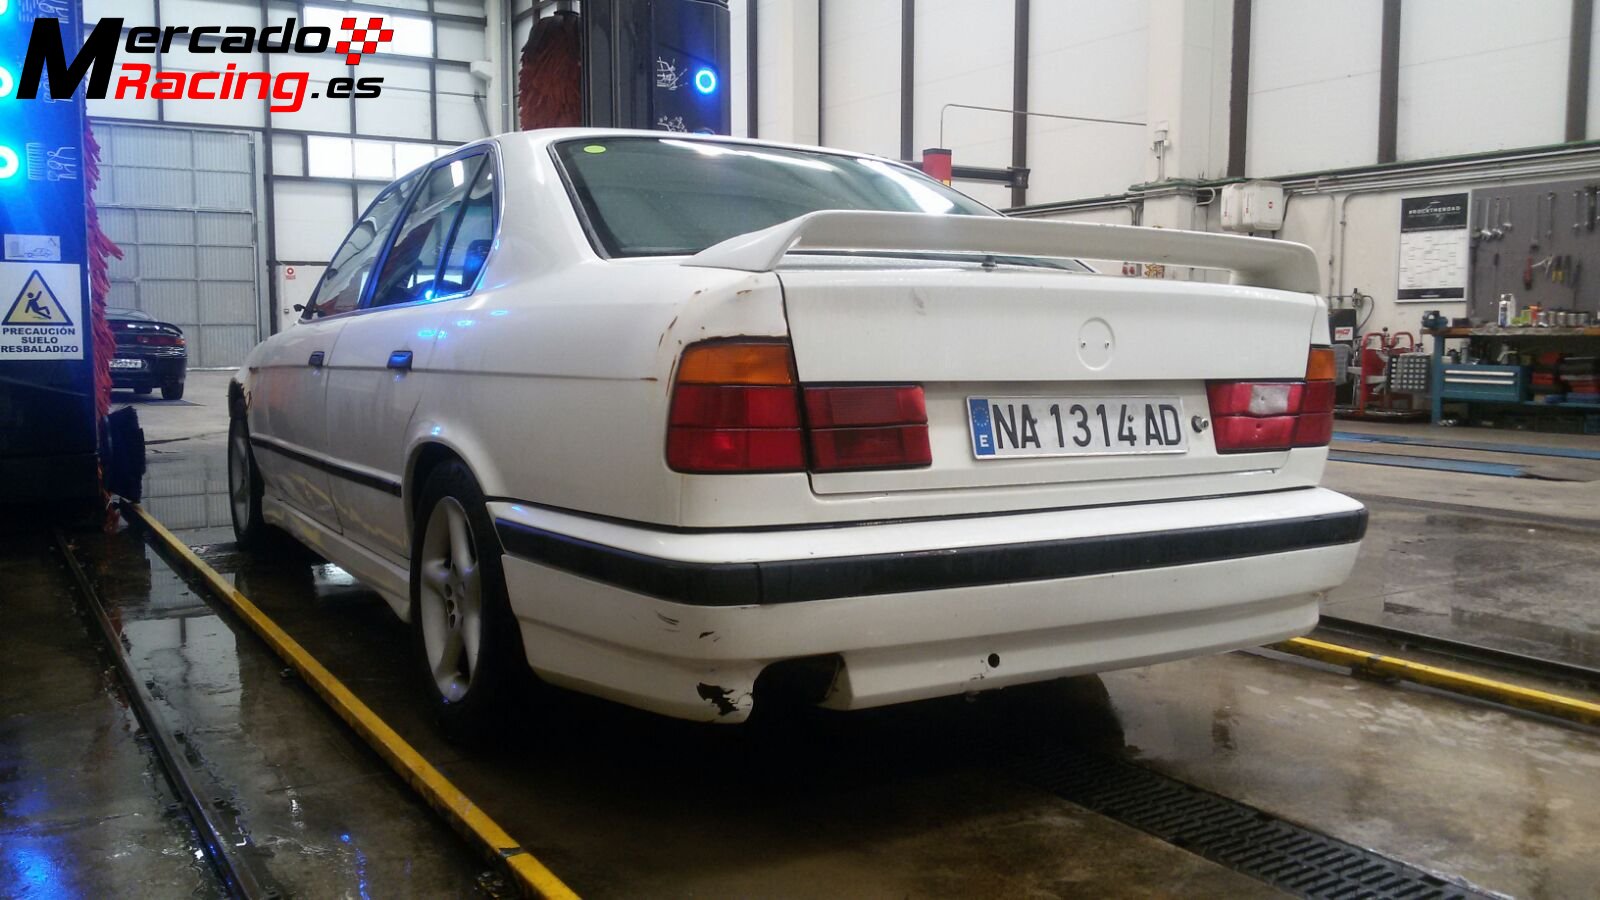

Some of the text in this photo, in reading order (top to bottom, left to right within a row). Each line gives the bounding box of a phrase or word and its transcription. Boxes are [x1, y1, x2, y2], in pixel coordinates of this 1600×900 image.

[2, 326, 76, 335] PRECAUCIÓN
[21, 336, 58, 344] SUELO
[1, 345, 79, 353] RESBALADIZO
[992, 404, 1182, 449] NA 1314 AD
[979, 434, 989, 448] E
